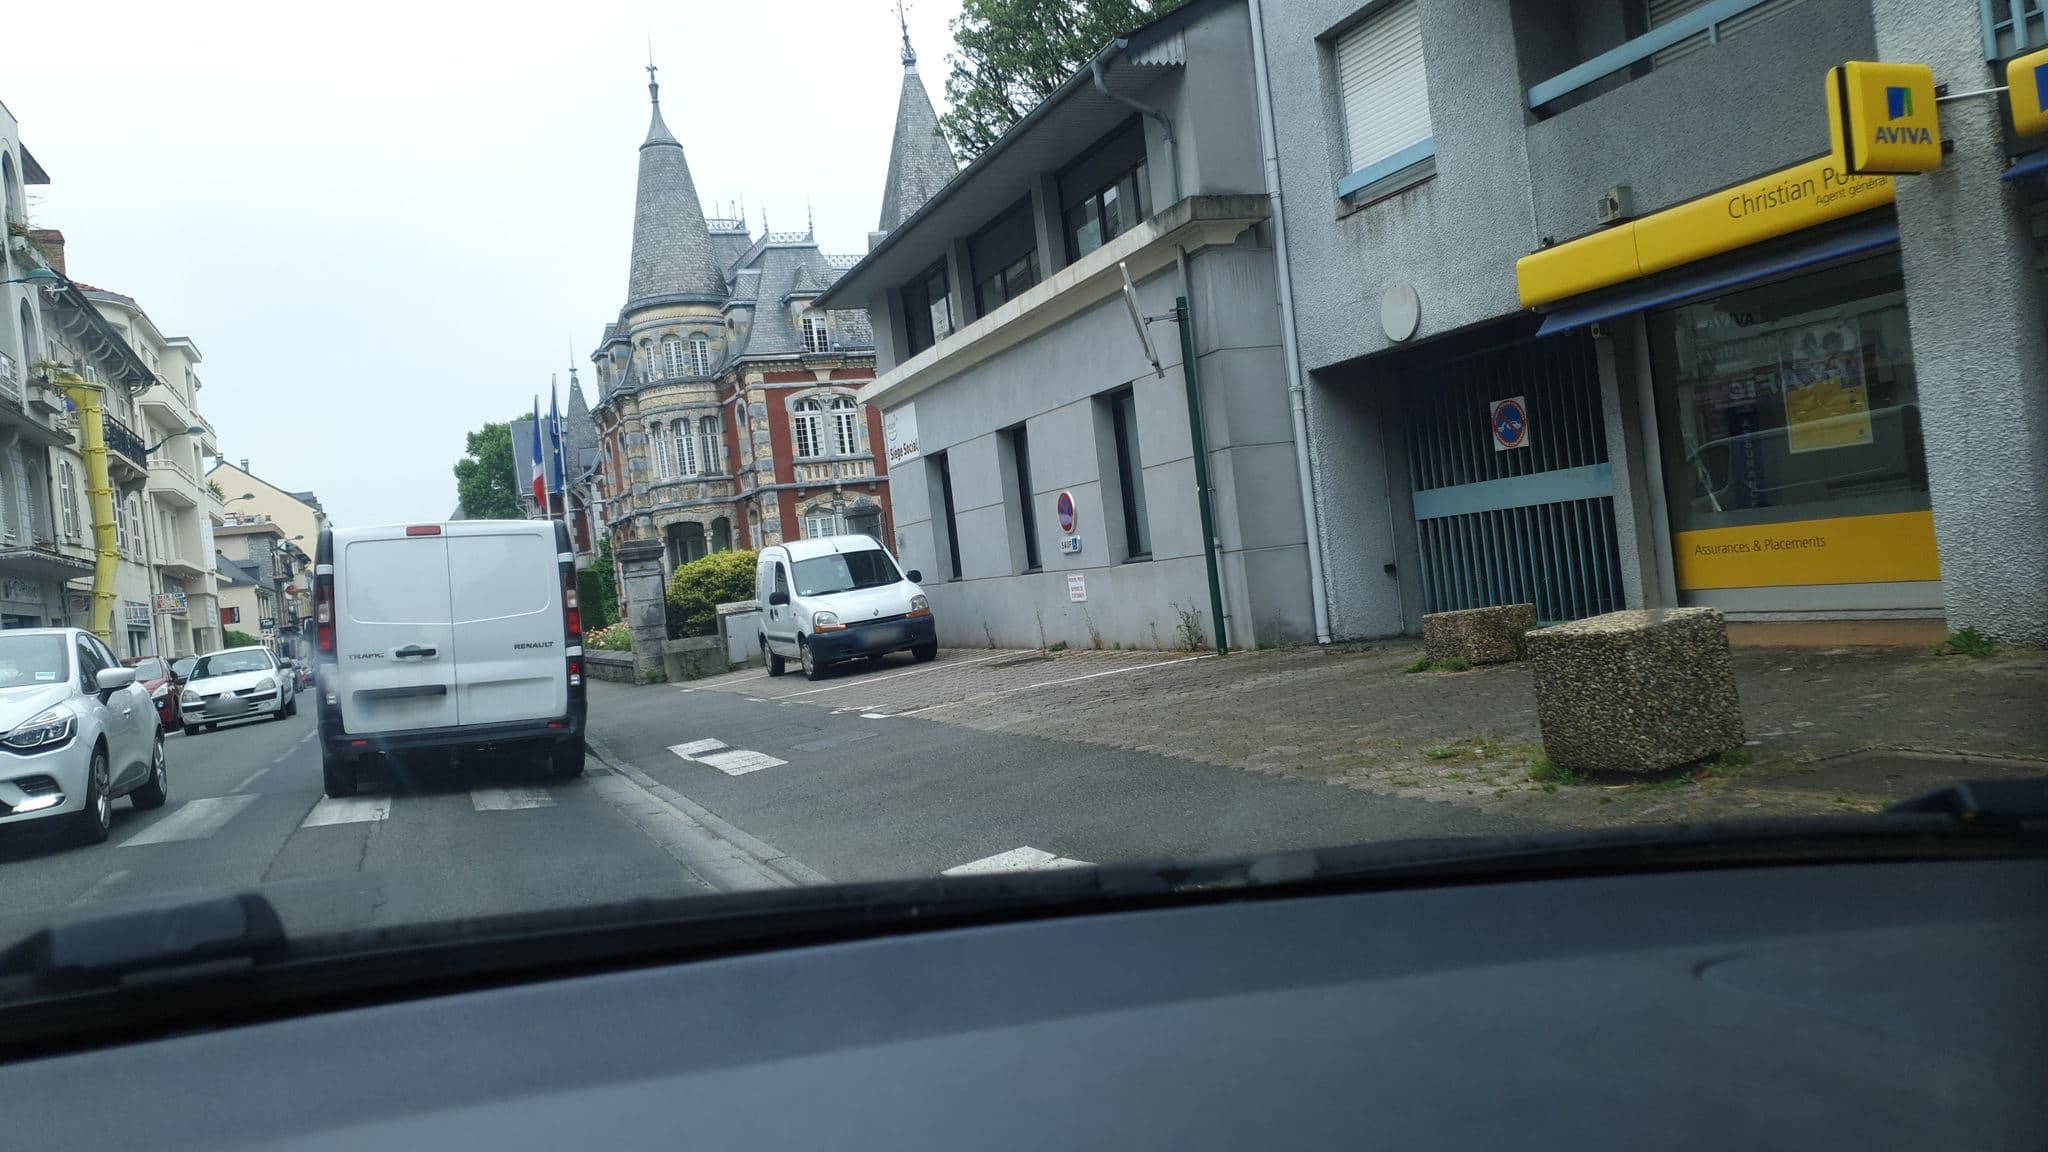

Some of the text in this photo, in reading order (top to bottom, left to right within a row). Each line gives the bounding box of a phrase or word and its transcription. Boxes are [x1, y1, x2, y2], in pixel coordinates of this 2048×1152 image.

[1874, 127, 1933, 145] AVIVA
[1728, 180, 1815, 219] Christian
[1816, 187, 1846, 207] Agent
[1695, 536, 1826, 555] Assurances & Placements
[513, 641, 554, 650] RENAULT
[345, 652, 385, 660] TRAFIC
